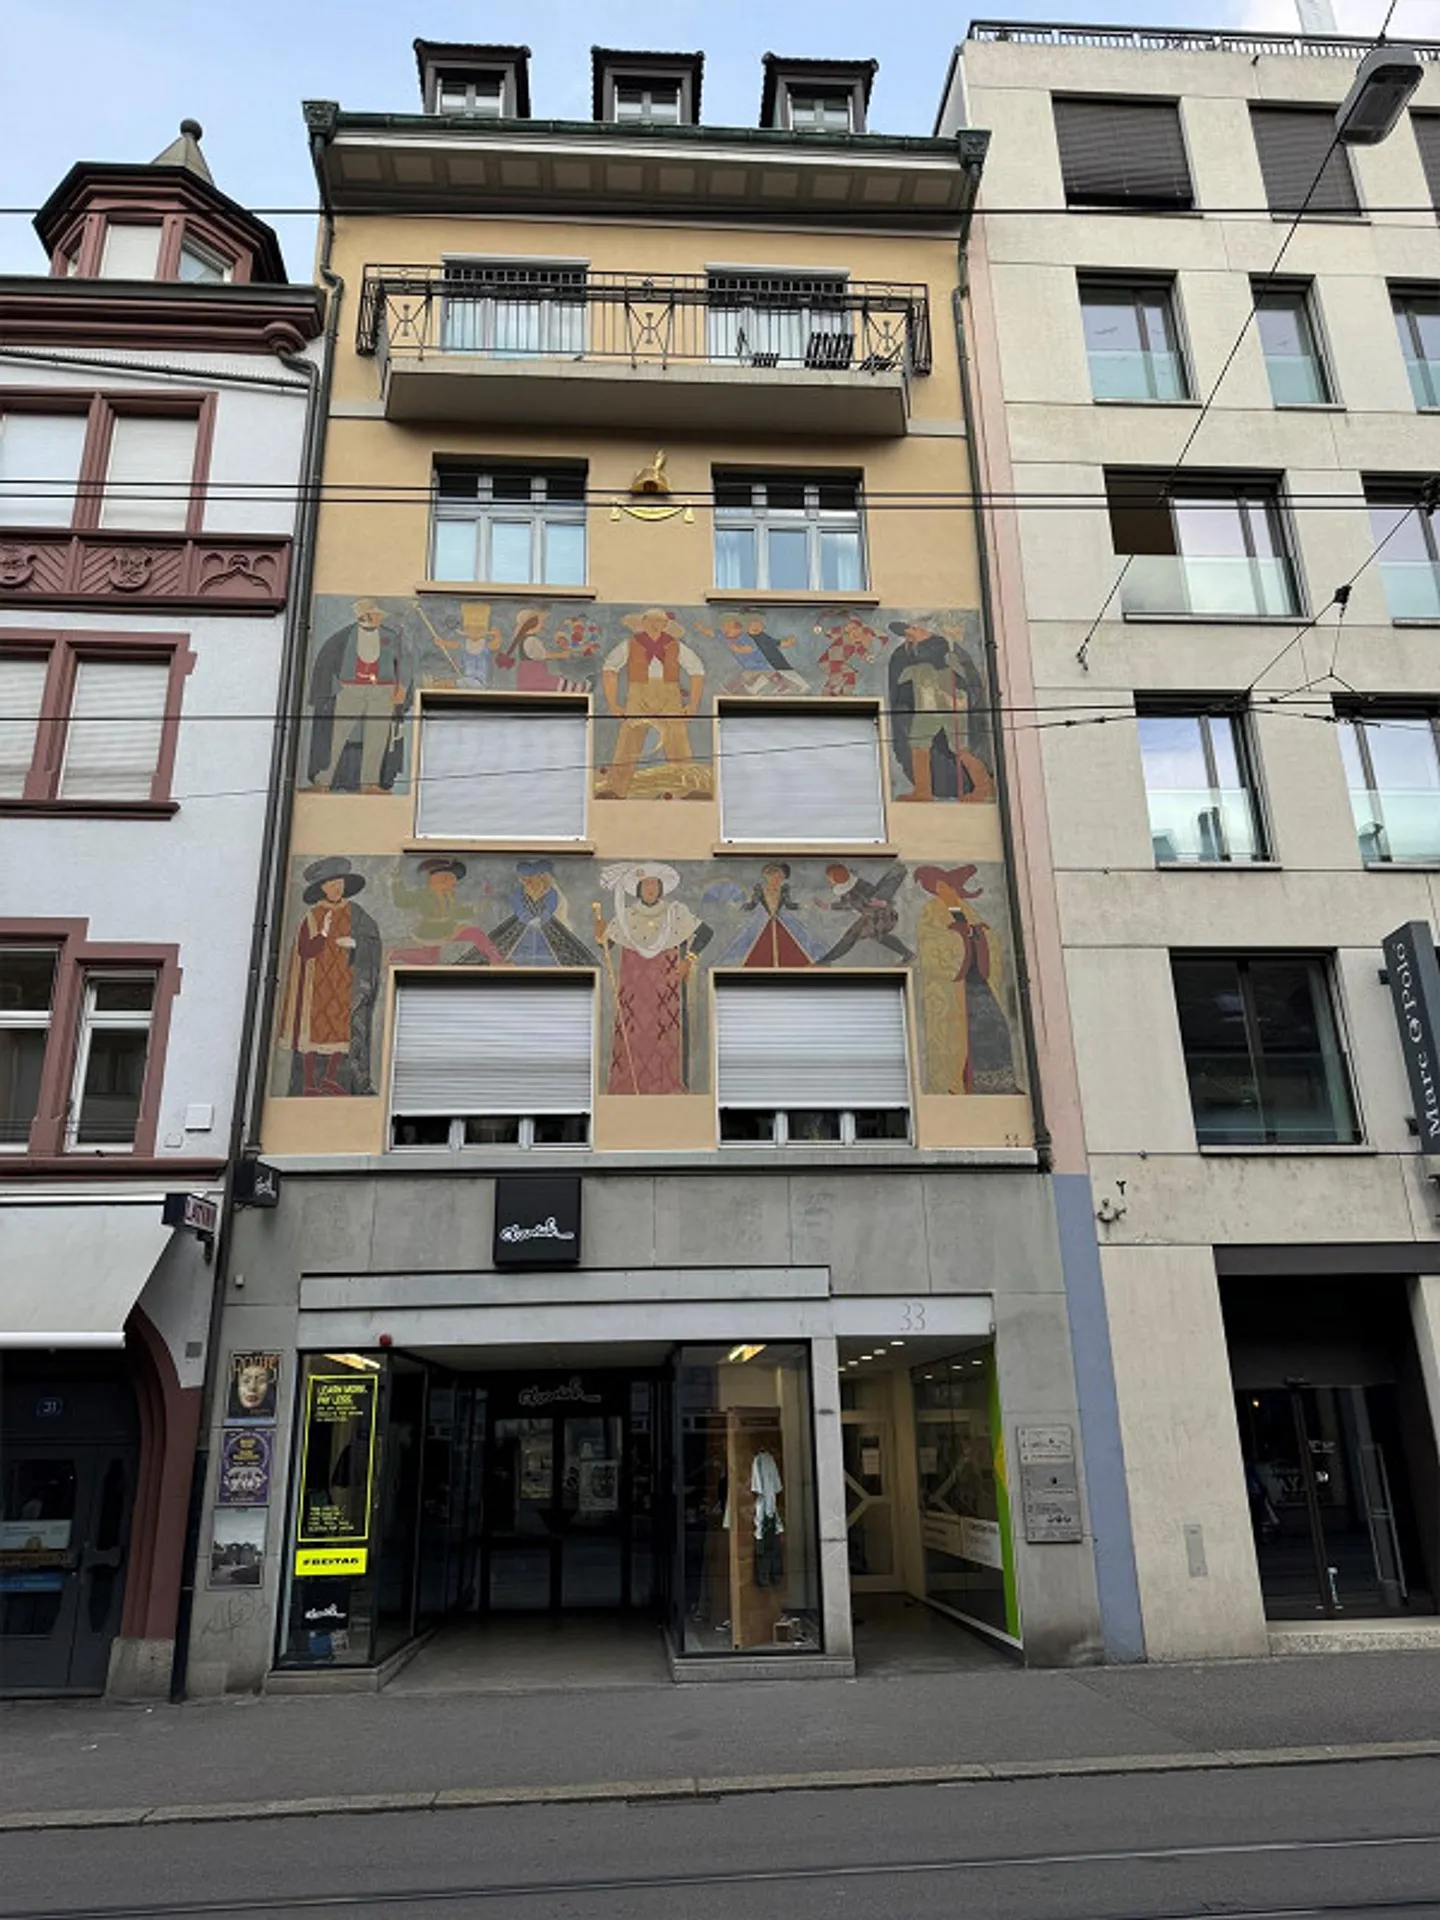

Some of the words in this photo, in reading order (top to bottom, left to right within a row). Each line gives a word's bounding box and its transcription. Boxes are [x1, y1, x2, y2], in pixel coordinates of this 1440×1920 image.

[1417, 1051, 1440, 1137] Marc
[900, 1303, 926, 1331] 33
[302, 1557, 359, 1566] FREITAG
